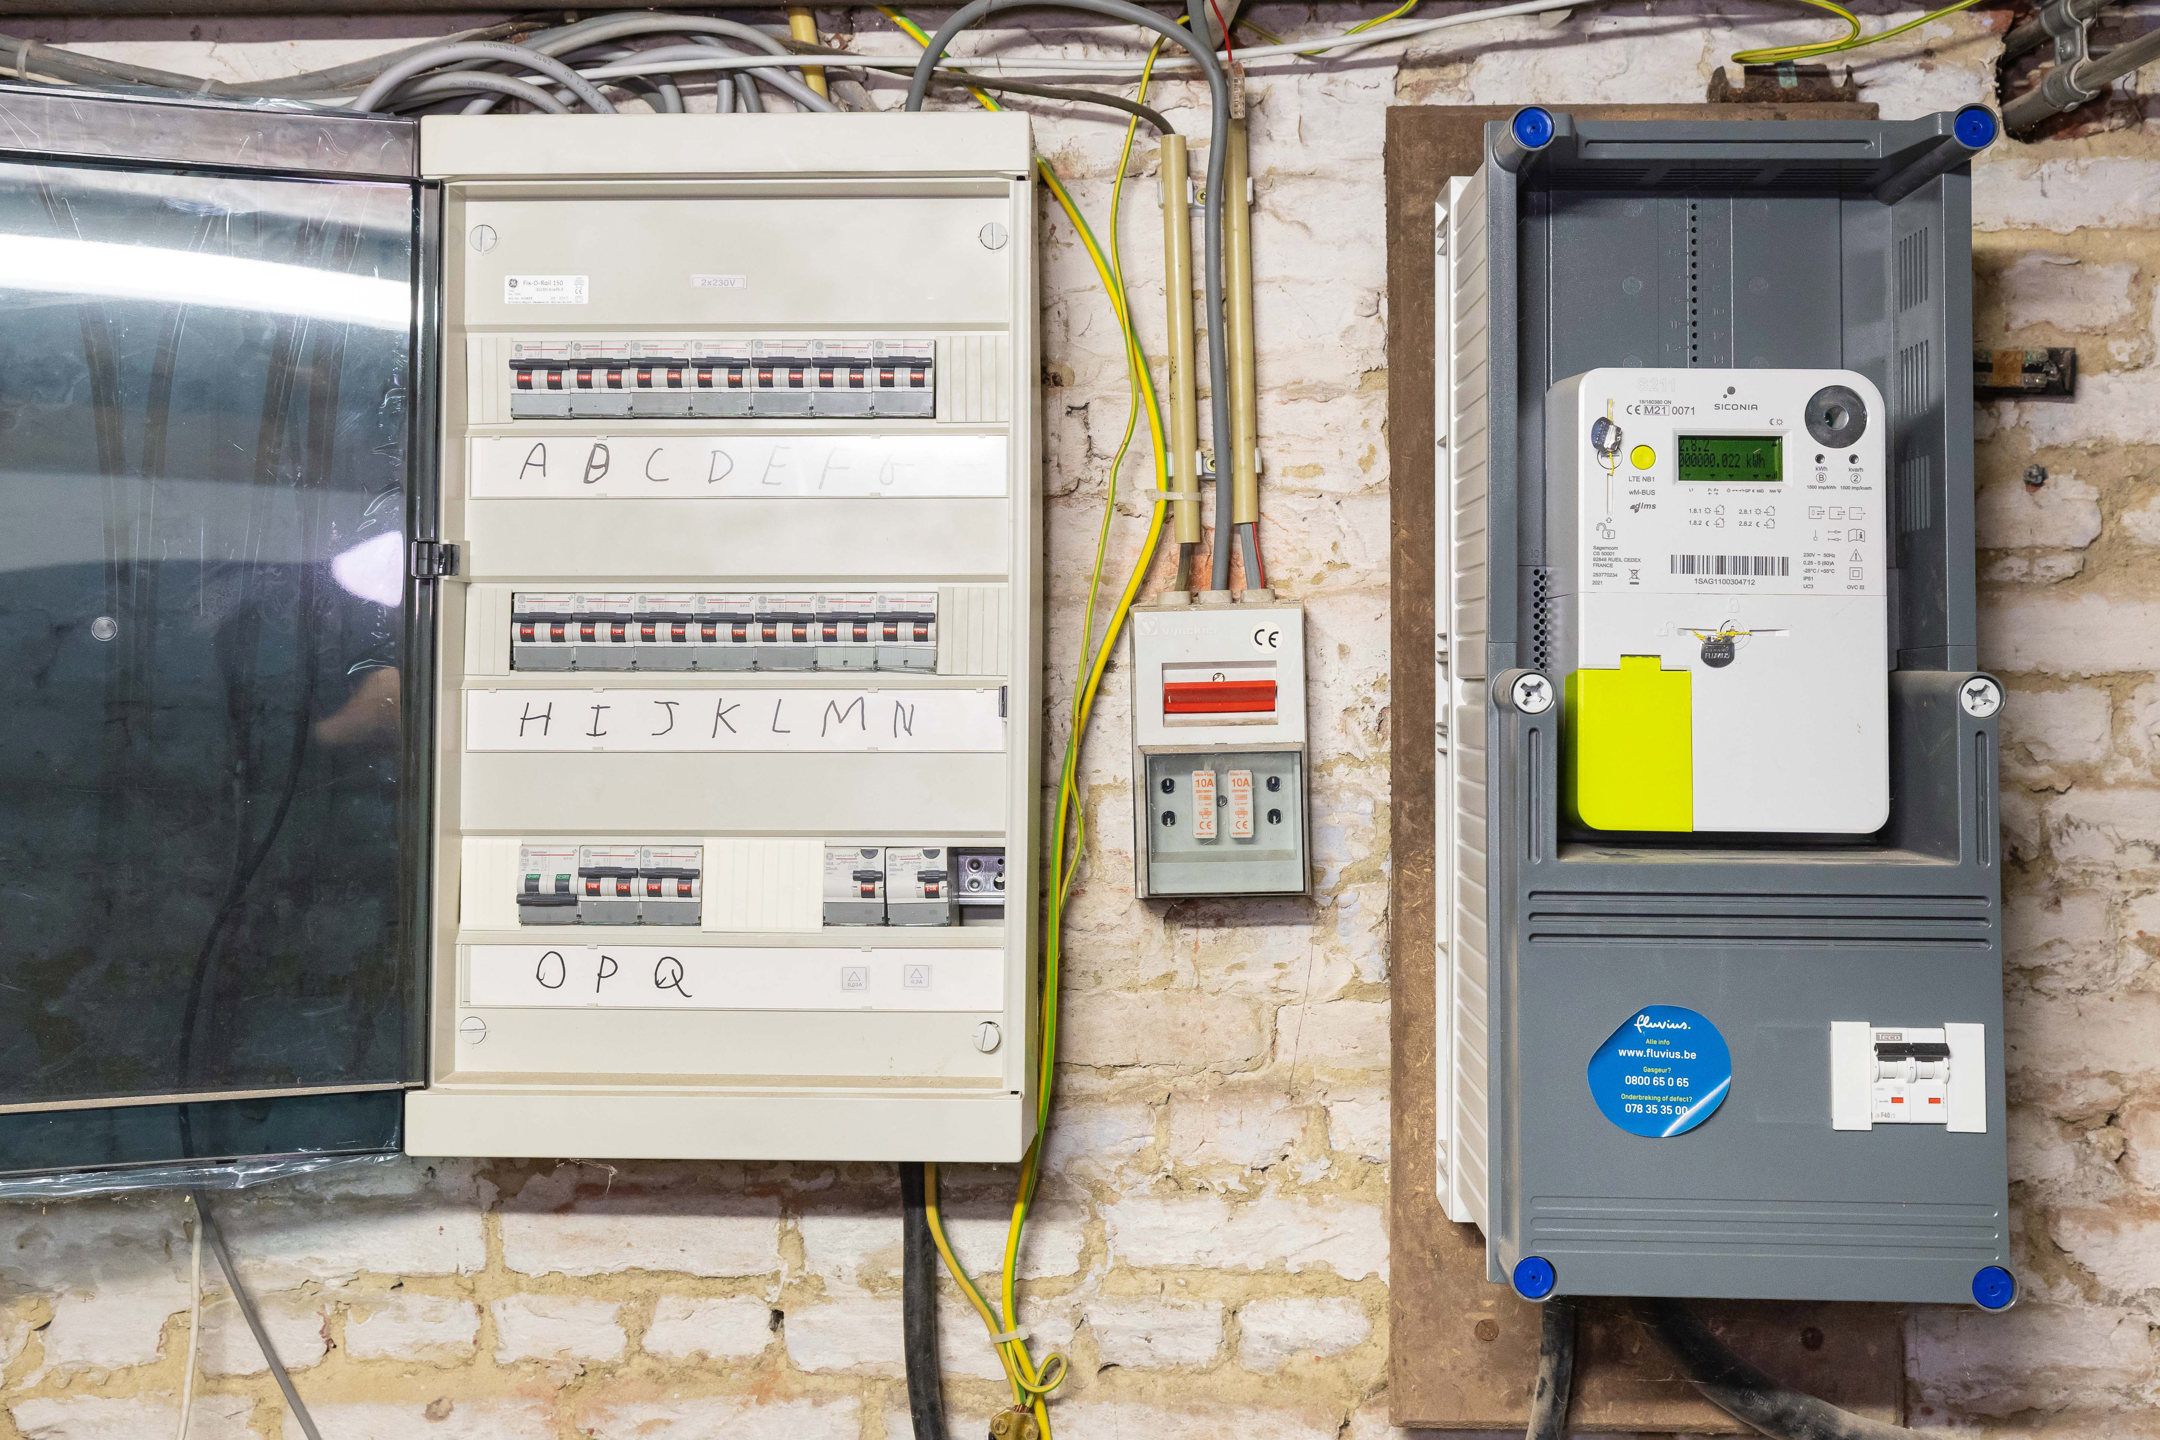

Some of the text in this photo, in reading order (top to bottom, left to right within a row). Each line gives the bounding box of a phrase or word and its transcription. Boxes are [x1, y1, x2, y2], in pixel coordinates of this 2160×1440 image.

[700, 279, 736, 287] 2x230V
[1644, 406, 1666, 414] M21
[1672, 406, 1696, 416] 0071
[1714, 403, 1758, 411] SICONIA
[520, 442, 546, 480] A
[583, 442, 610, 484] B
[645, 448, 670, 482] C
[708, 450, 734, 484] D
[761, 446, 792, 485] E
[520, 696, 914, 738] H I J K L M N
[1196, 778, 1214, 788] 10A
[1232, 778, 1250, 787] 10A
[536, 950, 692, 998] O P Q
[1618, 1049, 1697, 1059] www.fluvius.be
[1625, 1075, 1689, 1087] 0800 65 0 65
[1621, 1094, 1660, 1102] Onderbreking
[1625, 1104, 1688, 1115] 078 35 35 00
